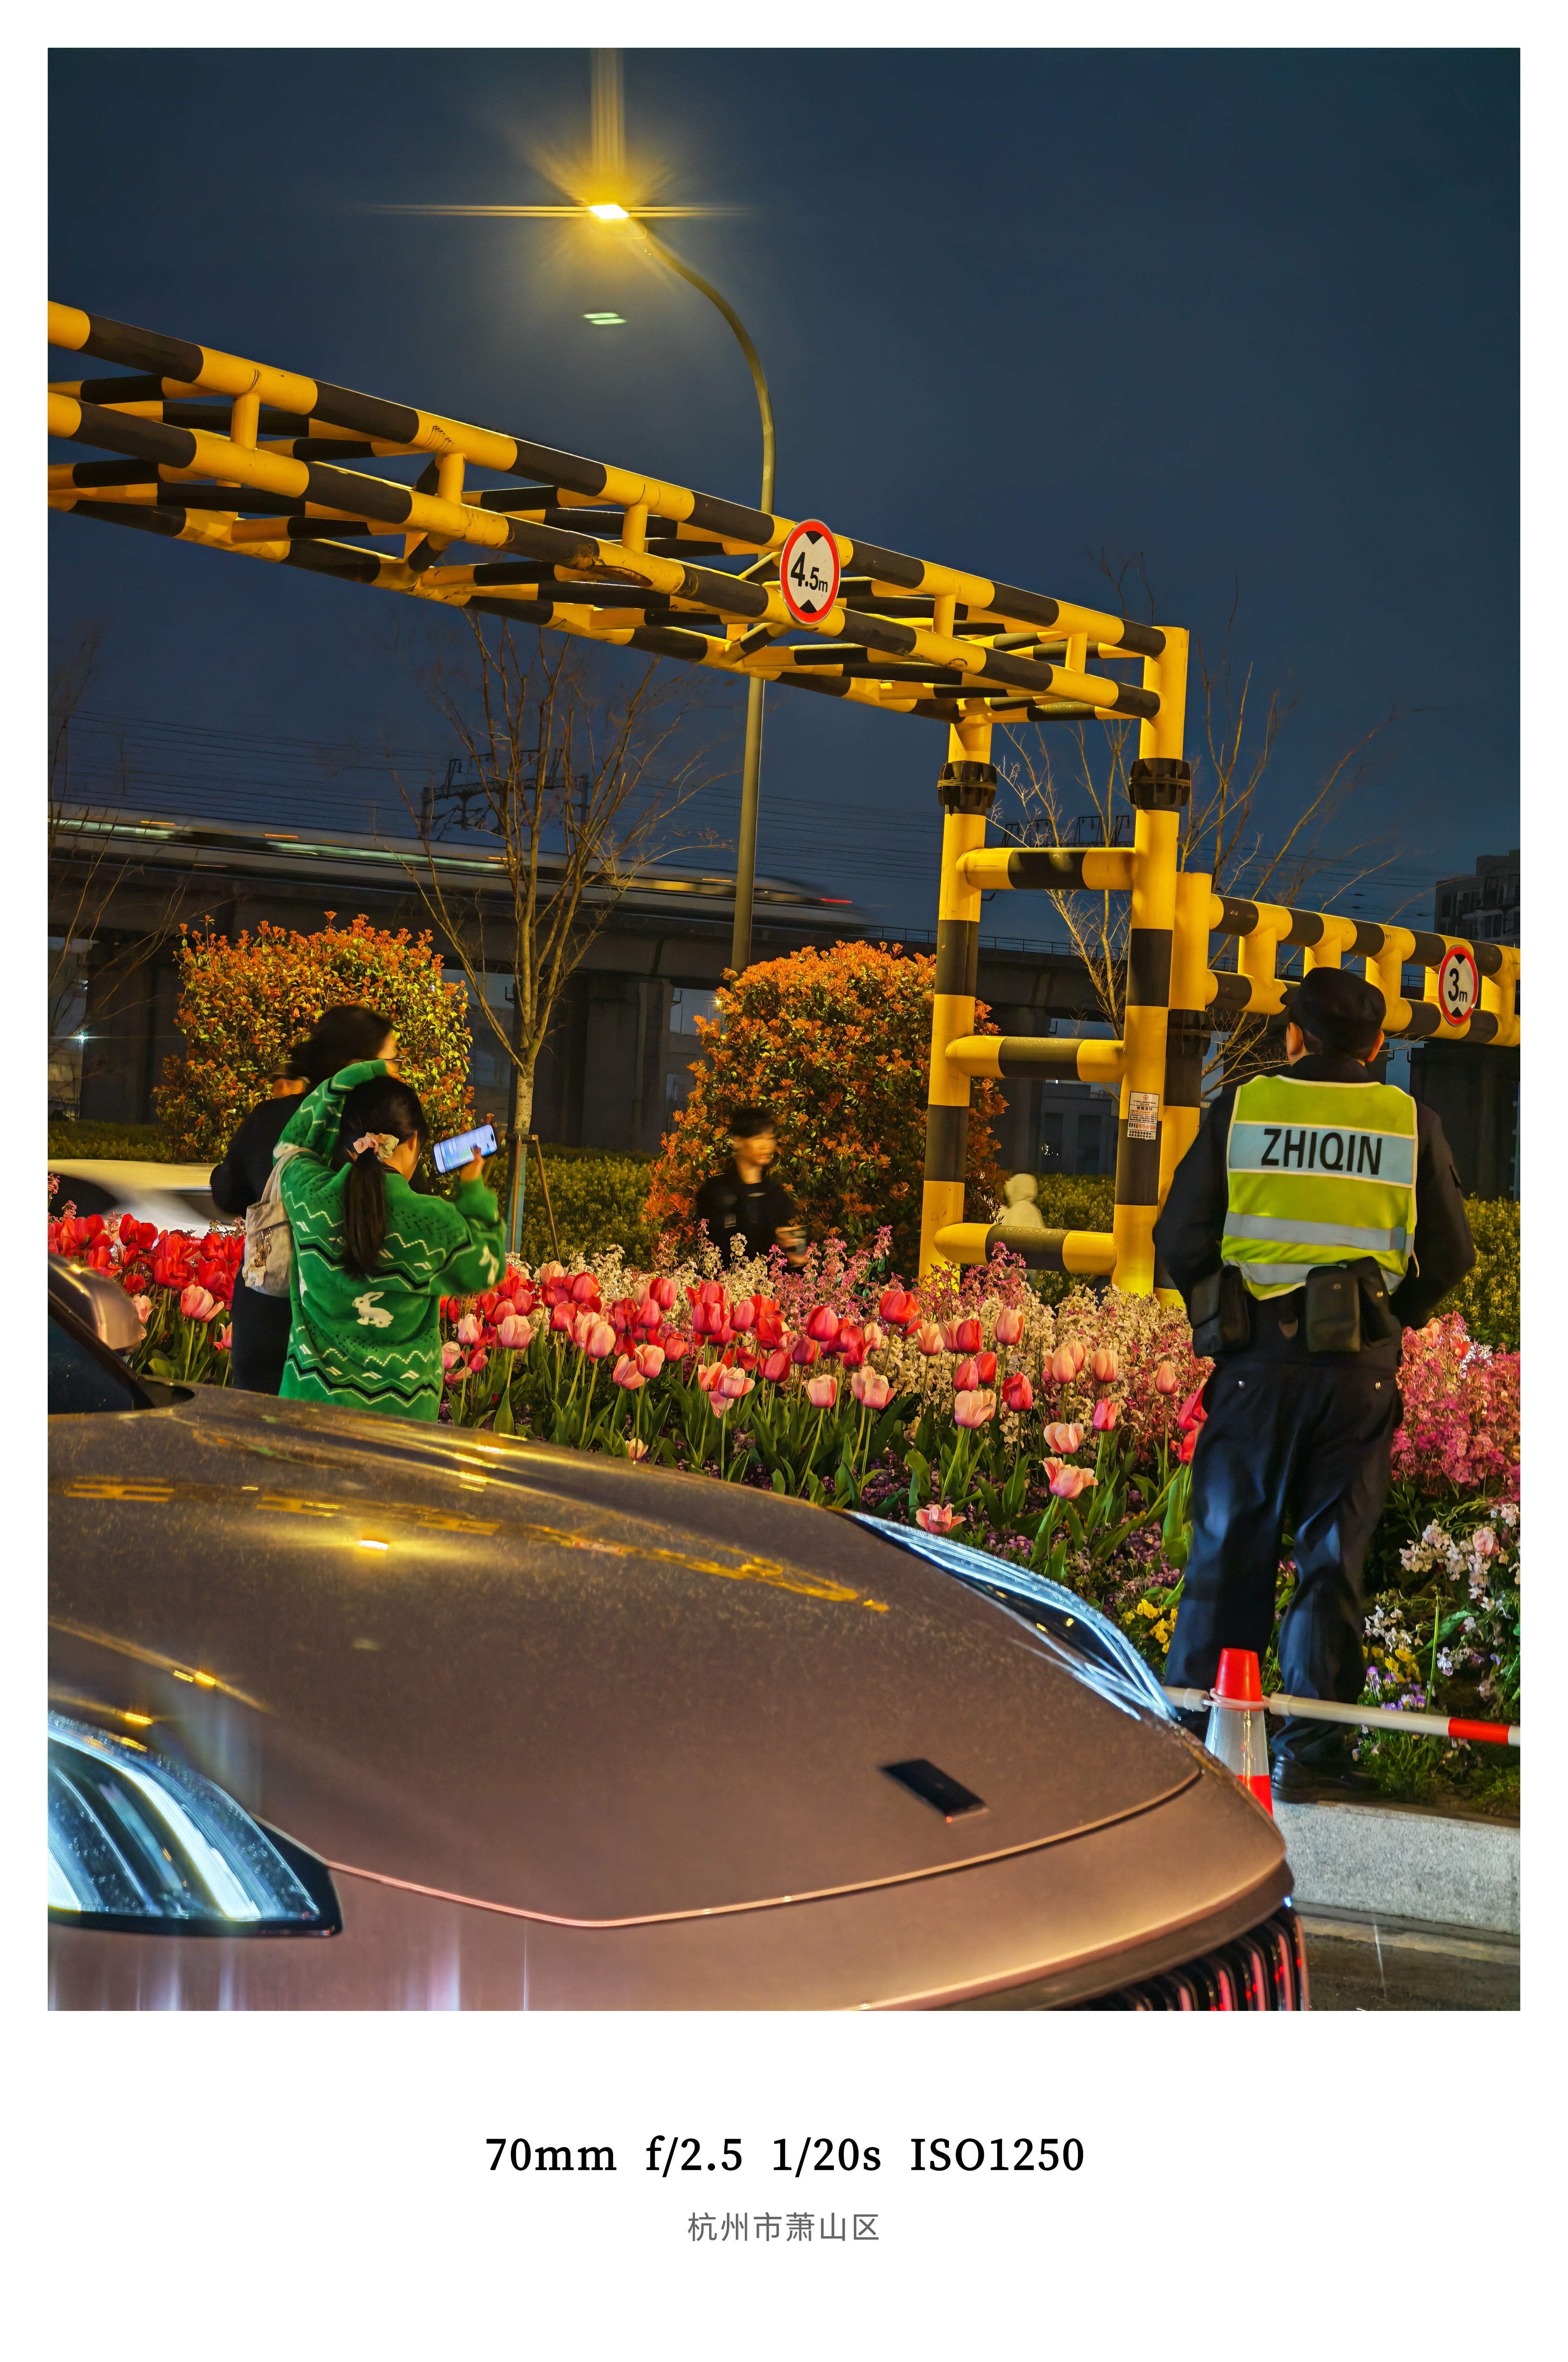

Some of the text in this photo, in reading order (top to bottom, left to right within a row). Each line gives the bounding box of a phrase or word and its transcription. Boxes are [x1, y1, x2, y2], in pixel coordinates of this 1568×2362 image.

[790, 551, 827, 593] 4.5m
[1448, 968, 1467, 1002] 3m
[1261, 1128, 1382, 1175] ZHIQIN
